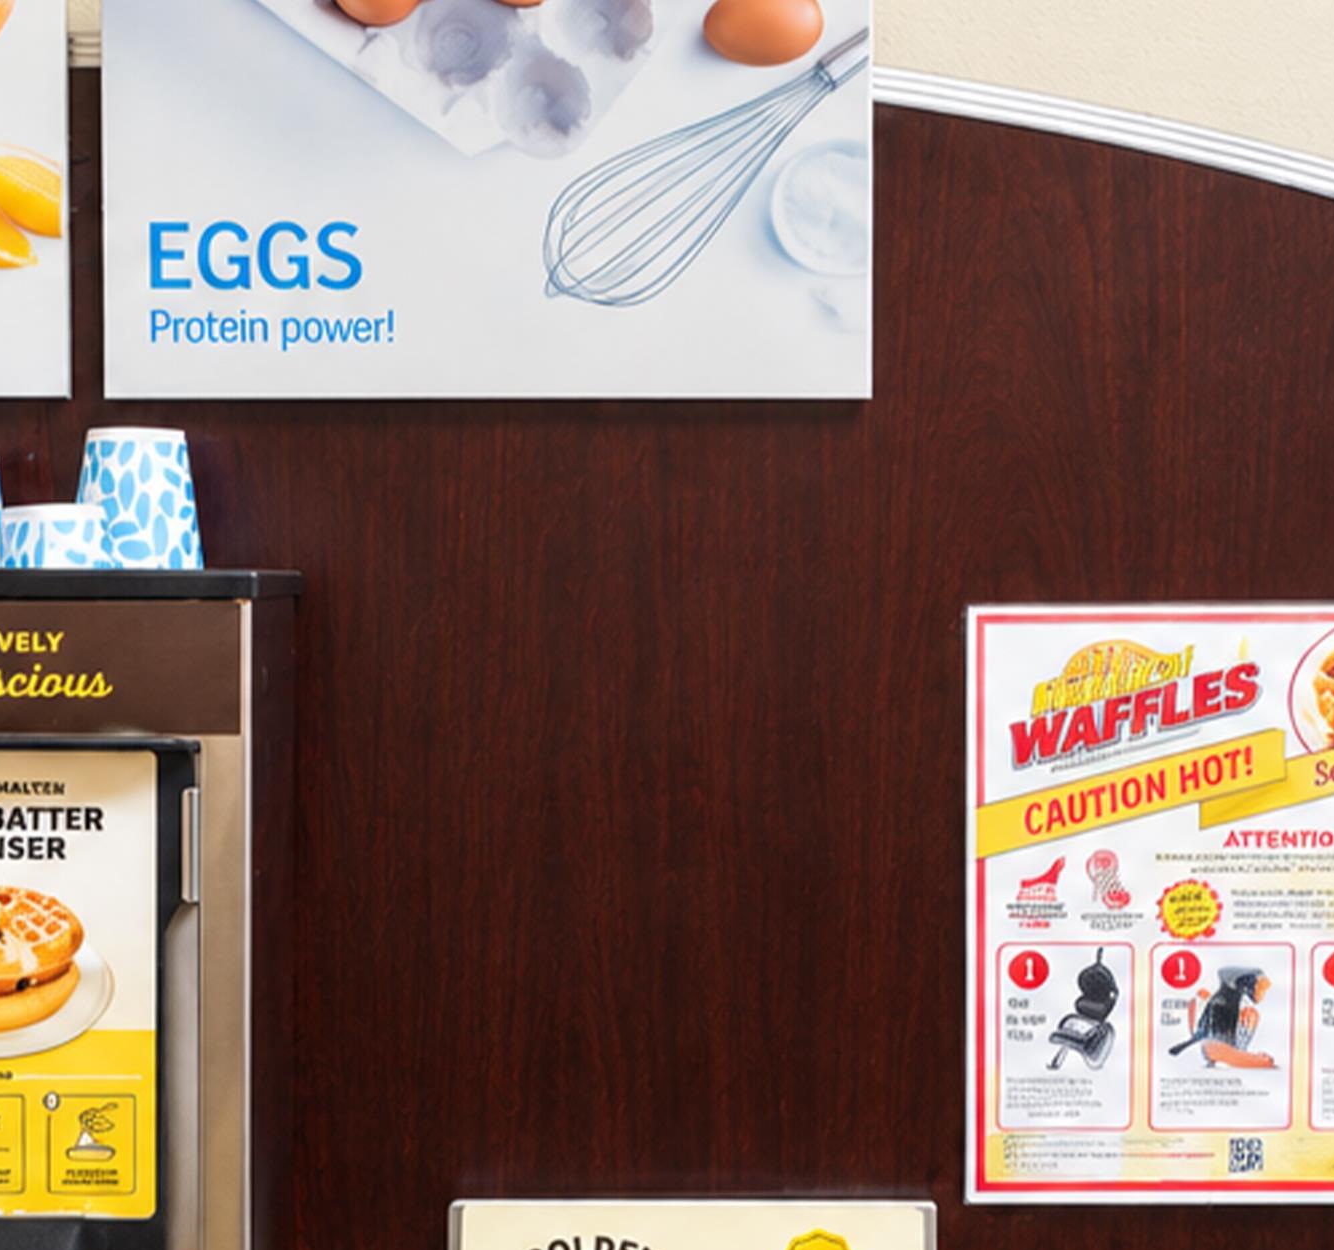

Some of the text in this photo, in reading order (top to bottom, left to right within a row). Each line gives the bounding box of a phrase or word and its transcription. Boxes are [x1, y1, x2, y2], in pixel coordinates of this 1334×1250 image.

[148, 221, 363, 291] EGGS
[149, 309, 395, 352] Protein power!
[1009, 661, 1262, 771] WAFFLES
[1024, 746, 1255, 836] CAUTION HOT!
